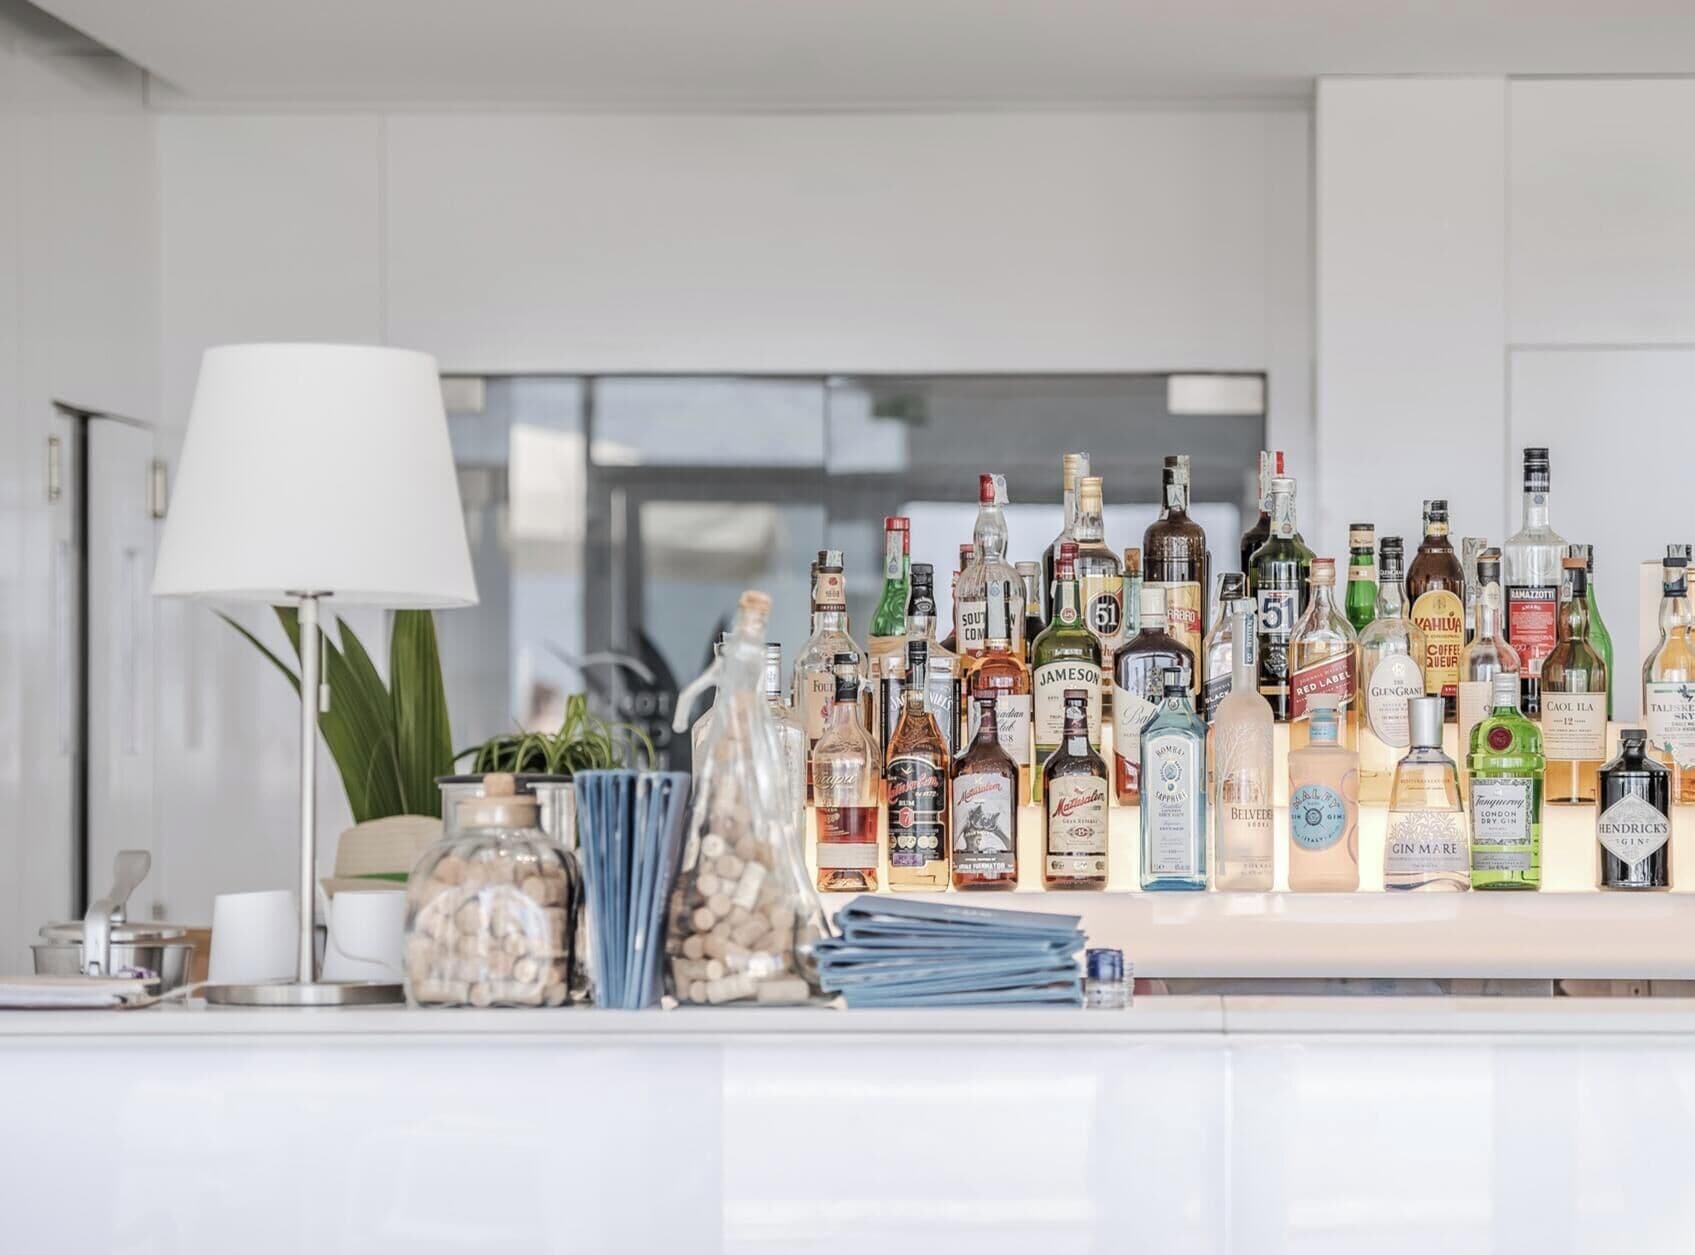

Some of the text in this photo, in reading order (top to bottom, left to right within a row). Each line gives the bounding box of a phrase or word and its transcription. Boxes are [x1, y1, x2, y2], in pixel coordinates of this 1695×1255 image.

[1511, 590, 1554, 599] RAMAZZOTTI
[1095, 602, 1118, 626] 51
[1263, 597, 1294, 629] 51
[1426, 656, 1458, 668] QUEUR
[1040, 668, 1099, 686] JAMESON
[1297, 683, 1317, 696] RED
[1319, 671, 1351, 687] LABEL
[1371, 686, 1423, 697] GLENGRANT
[1546, 701, 1594, 712] CAOL ILA
[1650, 703, 1695, 712] TALISKE
[1564, 717, 1573, 726] 12
[1155, 745, 1185, 757] BOMBAY
[1154, 791, 1188, 802] SAPPHIRE
[1292, 788, 1341, 810] MALFY
[1474, 795, 1525, 809] Tanqueray
[1052, 789, 1105, 818] Matusalem
[903, 811, 910, 823] 7
[1231, 807, 1273, 820] BELVEDE
[1599, 823, 1667, 834] HENDRICK'S
[1392, 843, 1458, 854] GIN MARE
